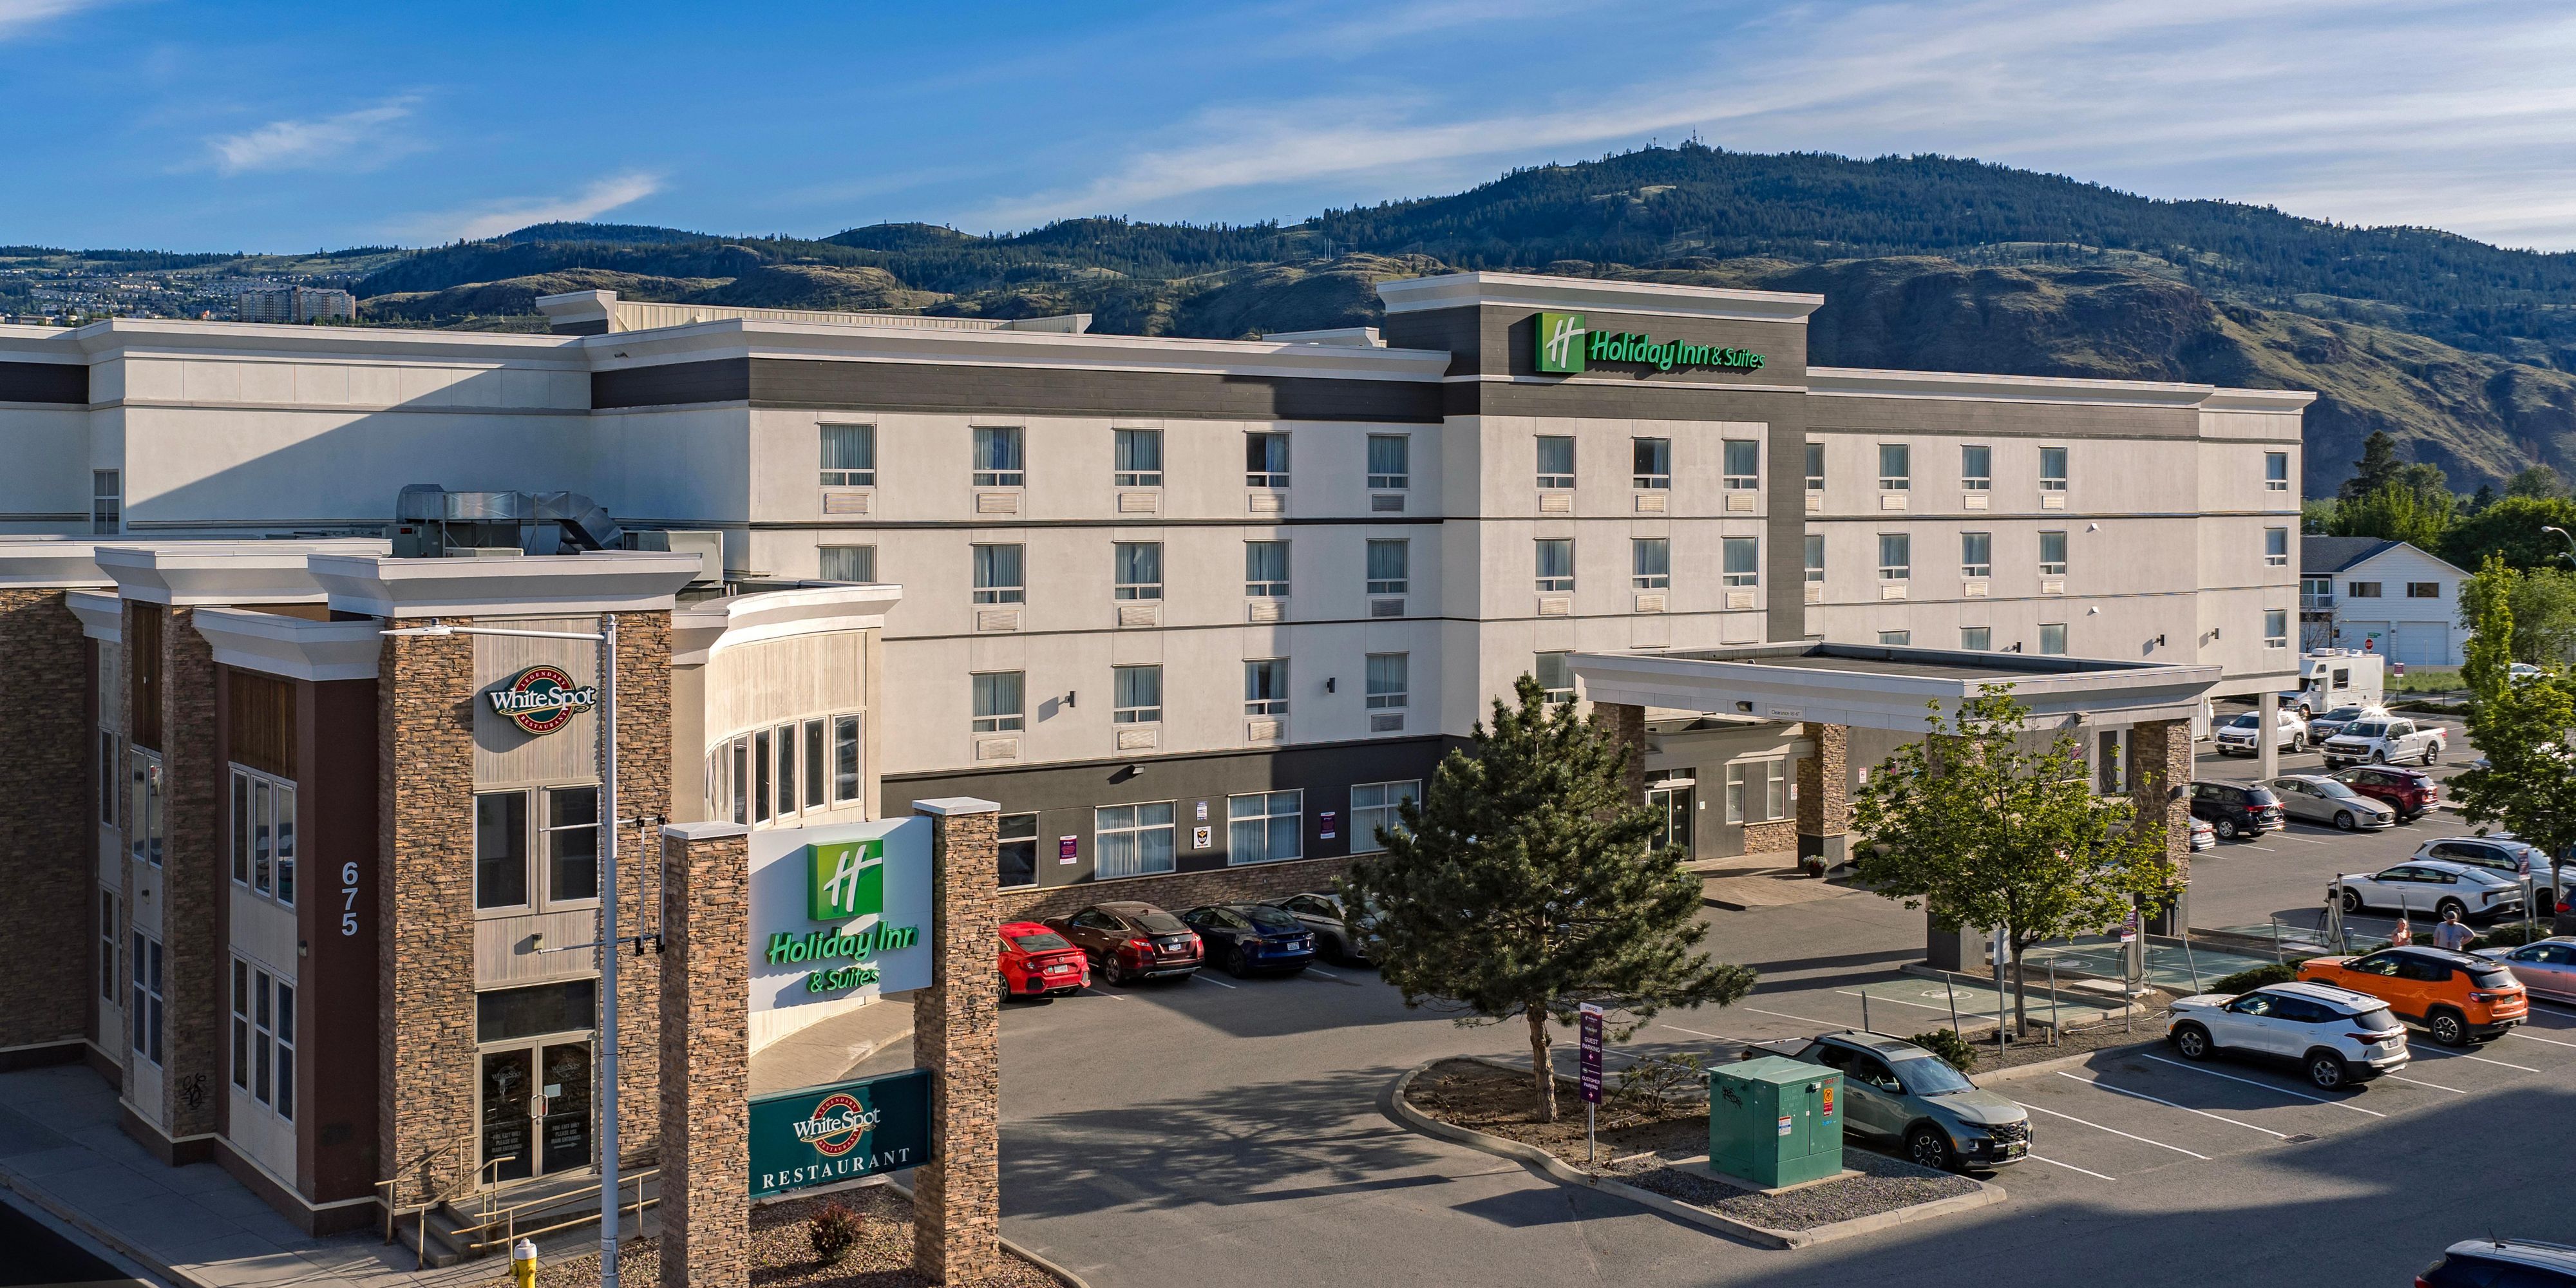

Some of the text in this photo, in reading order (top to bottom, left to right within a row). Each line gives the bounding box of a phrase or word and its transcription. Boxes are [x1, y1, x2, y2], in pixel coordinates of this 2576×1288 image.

[1590, 330, 1766, 370] Holiday Inn & Suites
[520, 671, 567, 687] LEGENDARY
[520, 712, 567, 729] RESTAURANT
[341, 862, 359, 936] 675
[768, 920, 920, 965] Holiday Inn
[809, 968, 880, 994] & Suites
[1582, 1043, 1600, 1053] PARKING
[1584, 1036, 1598, 1045] GUEST
[1582, 1075, 1600, 1084] CUSTOMER
[818, 1097, 857, 1115] LEGENDARY
[503, 1143, 522, 1151] ENTRANCE
[818, 1133, 858, 1152] RESTAURANT
[762, 1147, 910, 1189] RESTAURANT
